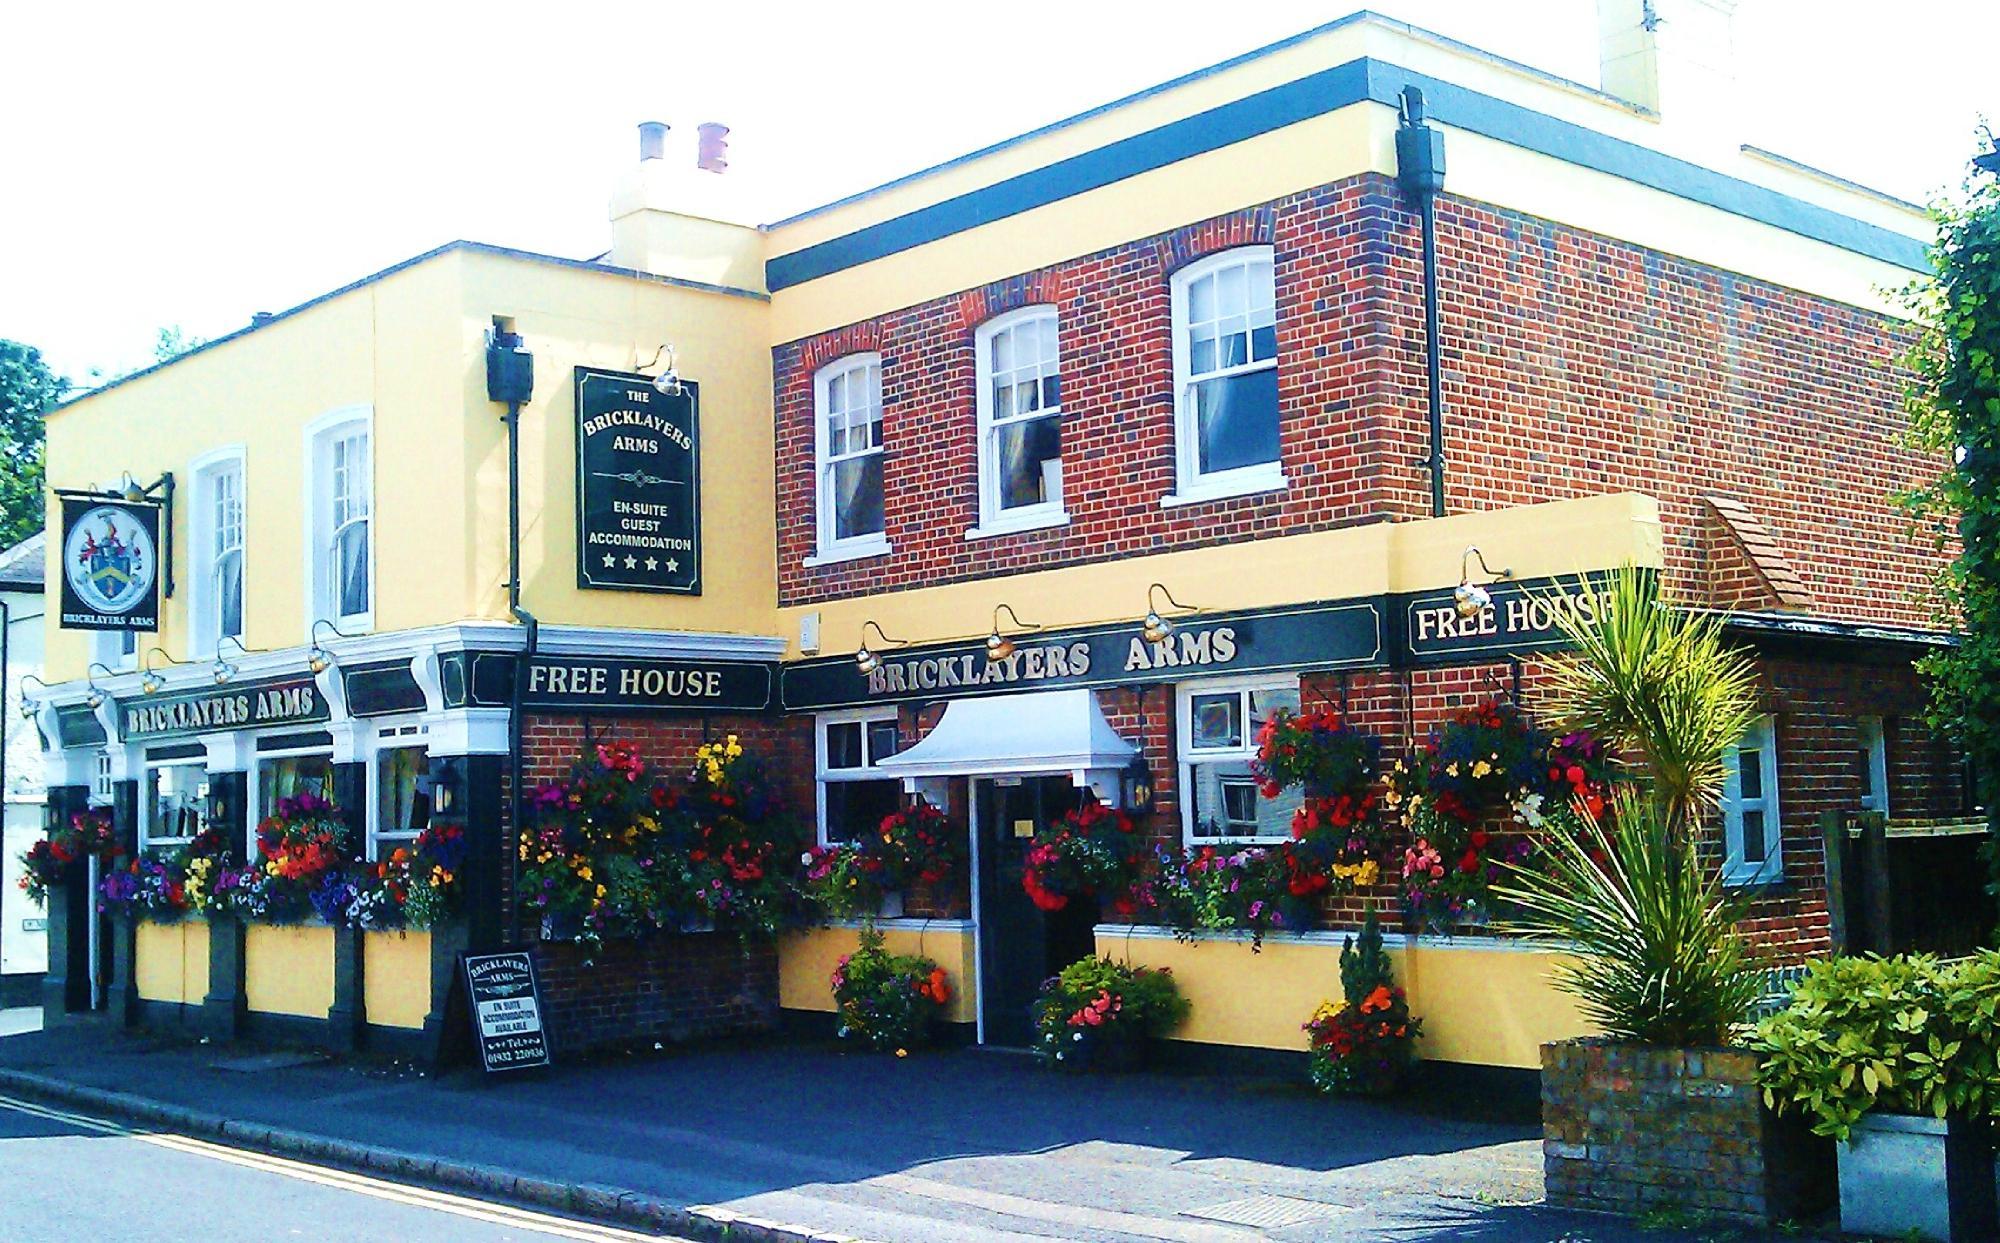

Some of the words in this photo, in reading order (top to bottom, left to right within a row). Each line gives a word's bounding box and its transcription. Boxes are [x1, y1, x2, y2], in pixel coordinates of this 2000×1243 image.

[627, 390, 649, 403] THE
[583, 410, 692, 450] BRICKLAYERS
[613, 436, 658, 454] ARMS
[613, 501, 668, 517] EN-SUITE
[621, 518, 661, 532] GUEST
[588, 532, 691, 551] ACCOMMODATION
[129, 616, 155, 626] ARMS
[1416, 603, 1498, 640] FREE
[869, 643, 1090, 694] BRICKLAYERS
[1124, 628, 1236, 671] ARMS
[529, 666, 608, 694] FREE
[619, 669, 722, 697] HOUSE
[127, 695, 249, 733] BRICKLAYERS
[255, 688, 314, 719] ARMS
[471, 960, 528, 977] BRICKLAYERS
[490, 973, 514, 983] ARMS
